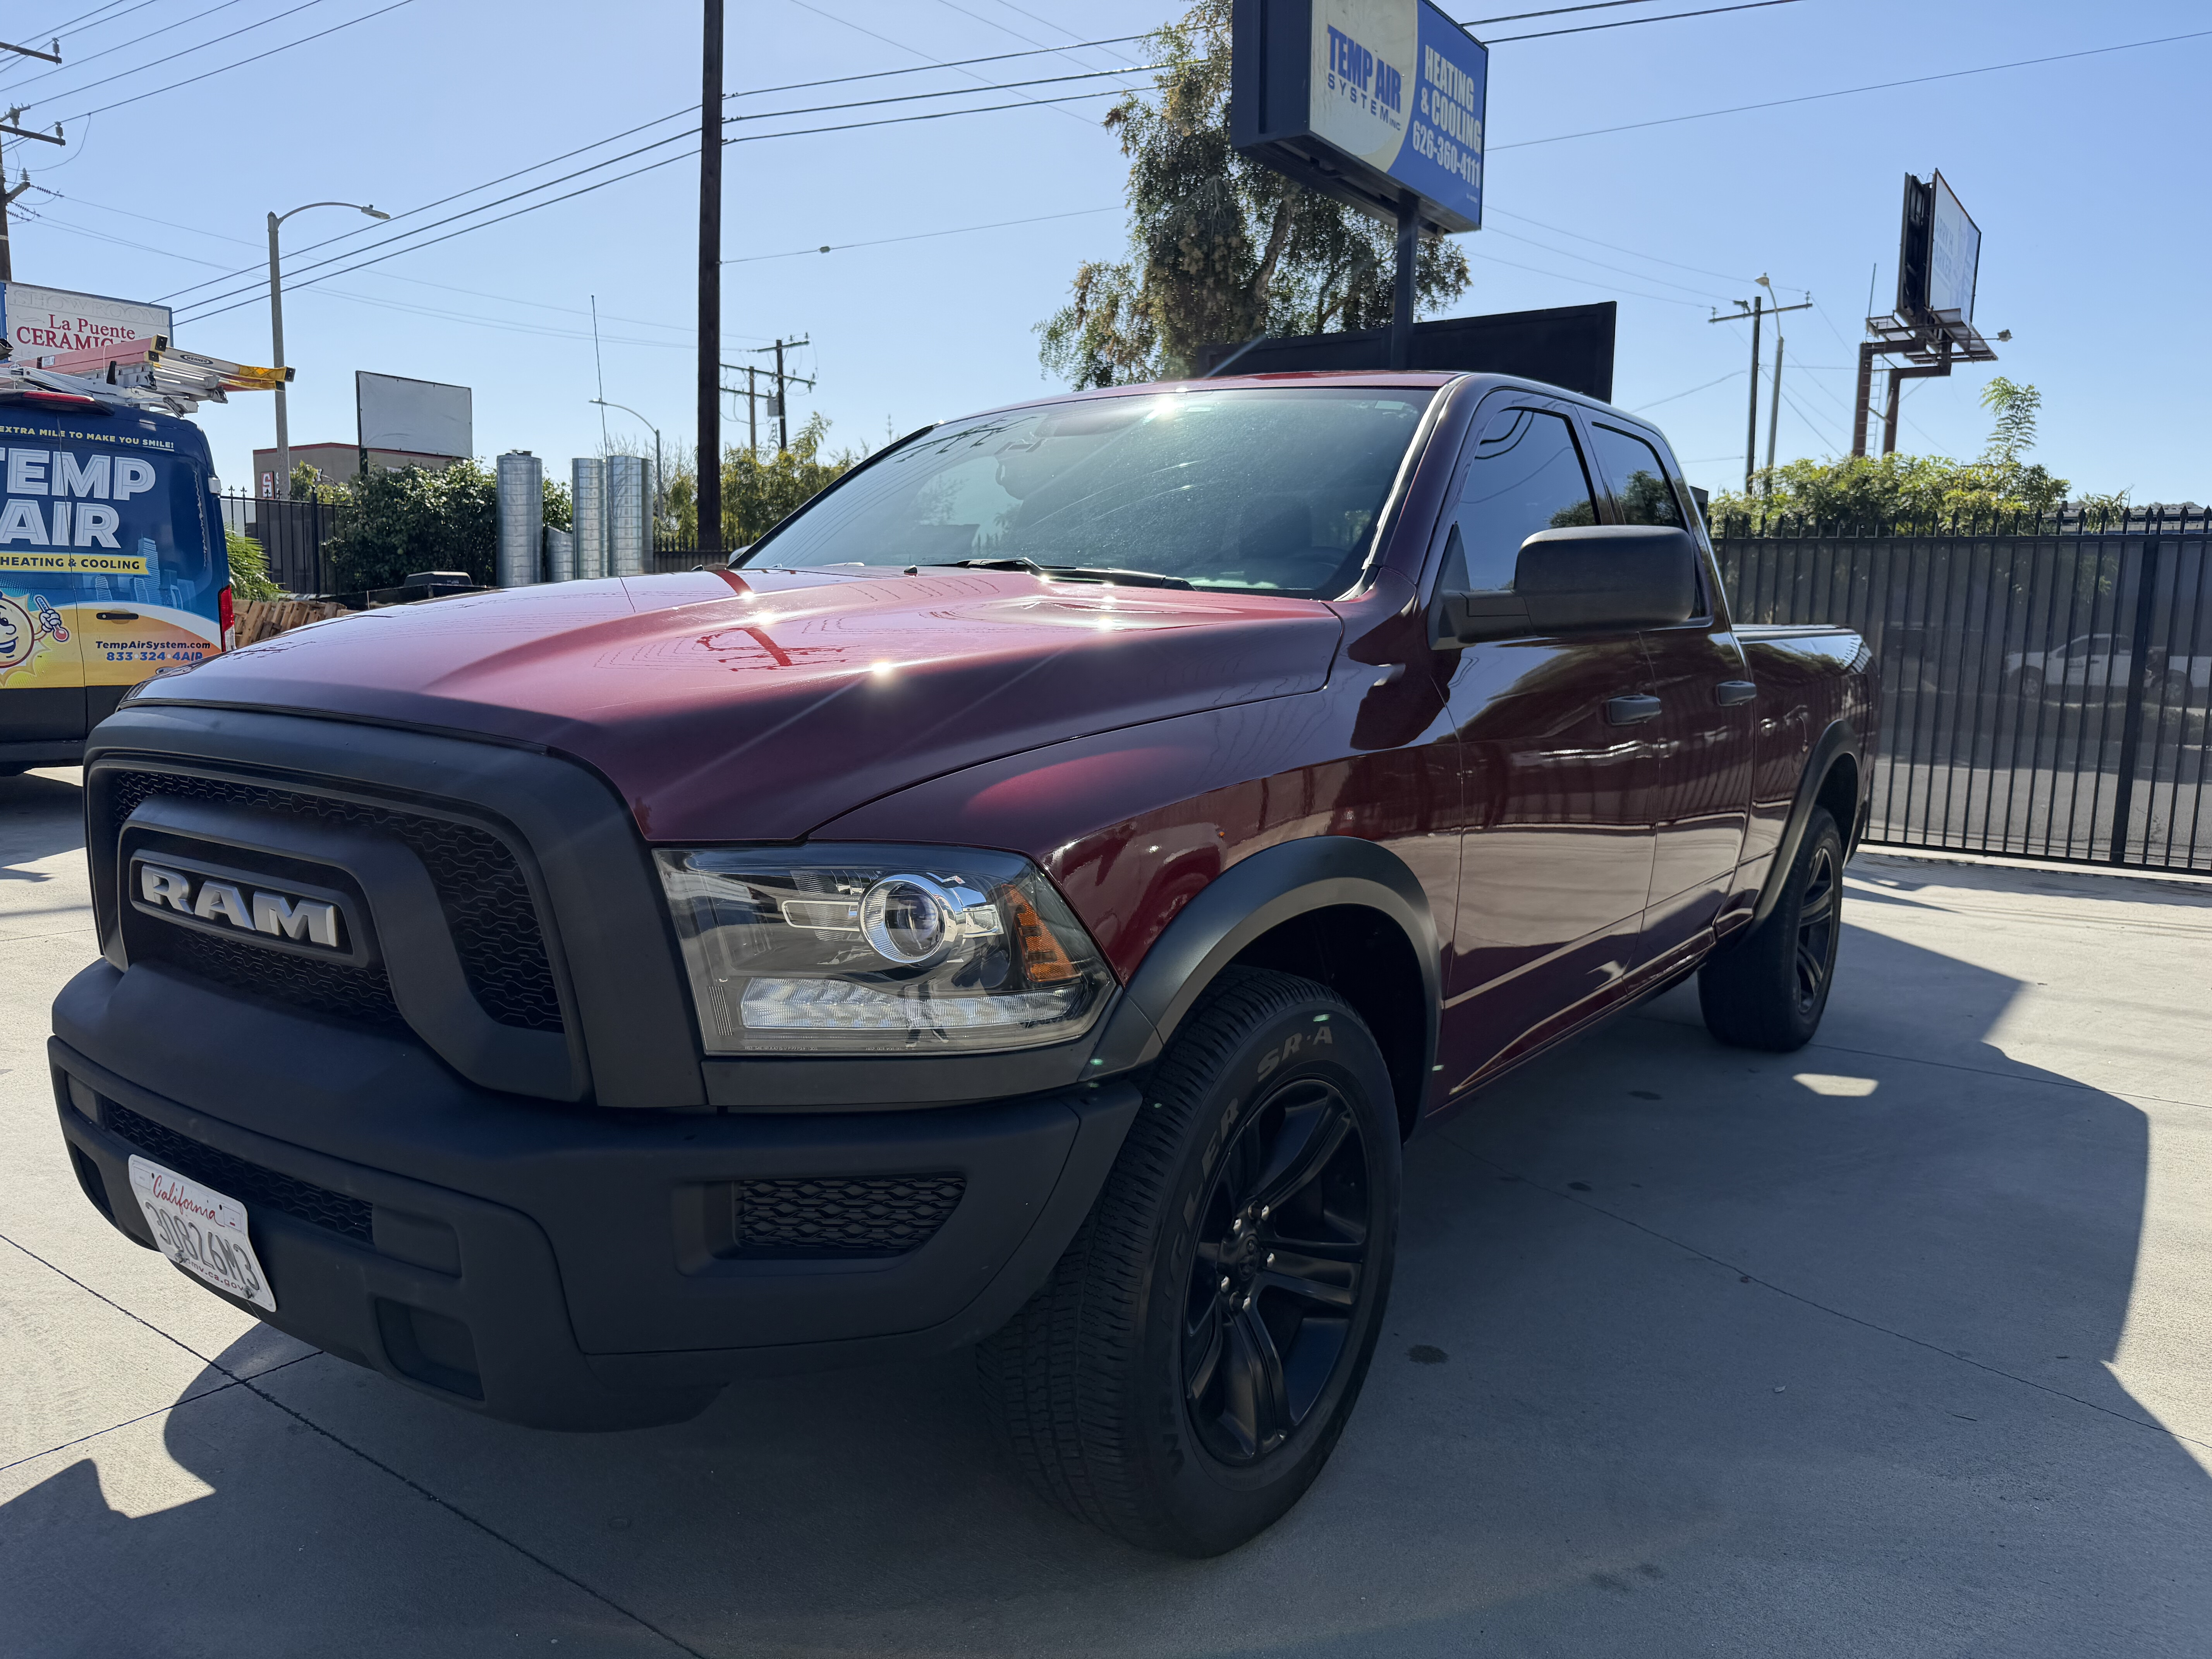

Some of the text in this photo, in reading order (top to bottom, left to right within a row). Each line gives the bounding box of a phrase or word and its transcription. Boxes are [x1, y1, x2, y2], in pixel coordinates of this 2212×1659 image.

[1327, 24, 1401, 114] TEMP AIR
[1424, 45, 1474, 112] HEATING
[1328, 72, 1389, 124] SYSTEM
[1420, 87, 1481, 155] & COOLING
[1412, 120, 1480, 189] 626-360-4111
[14, 289, 165, 325] SHOWROOM
[48, 314, 135, 340] La Puente
[0, 426, 36, 435] EXTRA
[87, 433, 115, 442] MAKE
[143, 439, 174, 448] SMILE!
[0, 447, 156, 501] EMP
[0, 498, 121, 548] AIR
[0, 556, 140, 570] HEATING & COOLING
[96, 641, 210, 650] TempAirSystem.com
[106, 652, 133, 661] 833
[140, 652, 166, 661] 324
[141, 864, 338, 947] RAM
[153, 1175, 225, 1227] California
[145, 1202, 260, 1290] 30826M3
